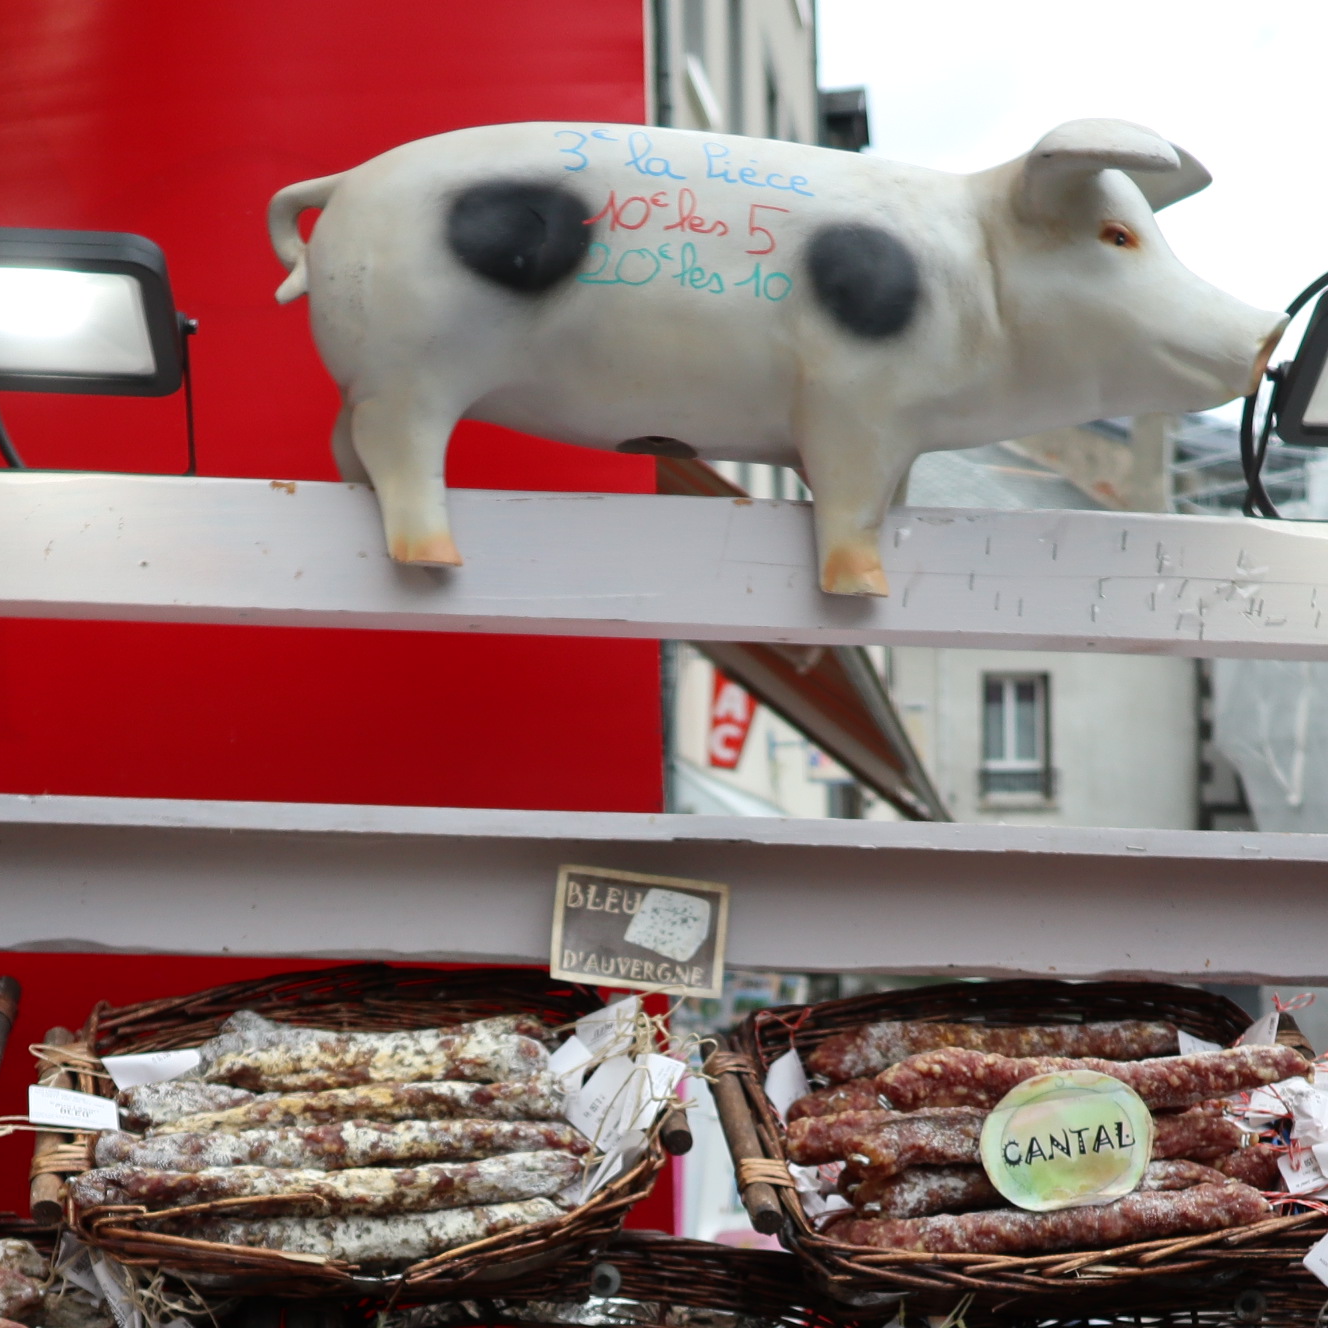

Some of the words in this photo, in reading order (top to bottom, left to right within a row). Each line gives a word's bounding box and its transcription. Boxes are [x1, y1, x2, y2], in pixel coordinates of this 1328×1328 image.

[625, 131, 687, 180] la
[664, 187, 729, 237] les
[745, 203, 791, 255] 5
[672, 241, 725, 294] les
[734, 262, 793, 302] 10
[565, 881, 642, 915] BLEU
[561, 949, 705, 987] D'AUVERGNE
[1002, 1120, 1137, 1169] CANTAL
